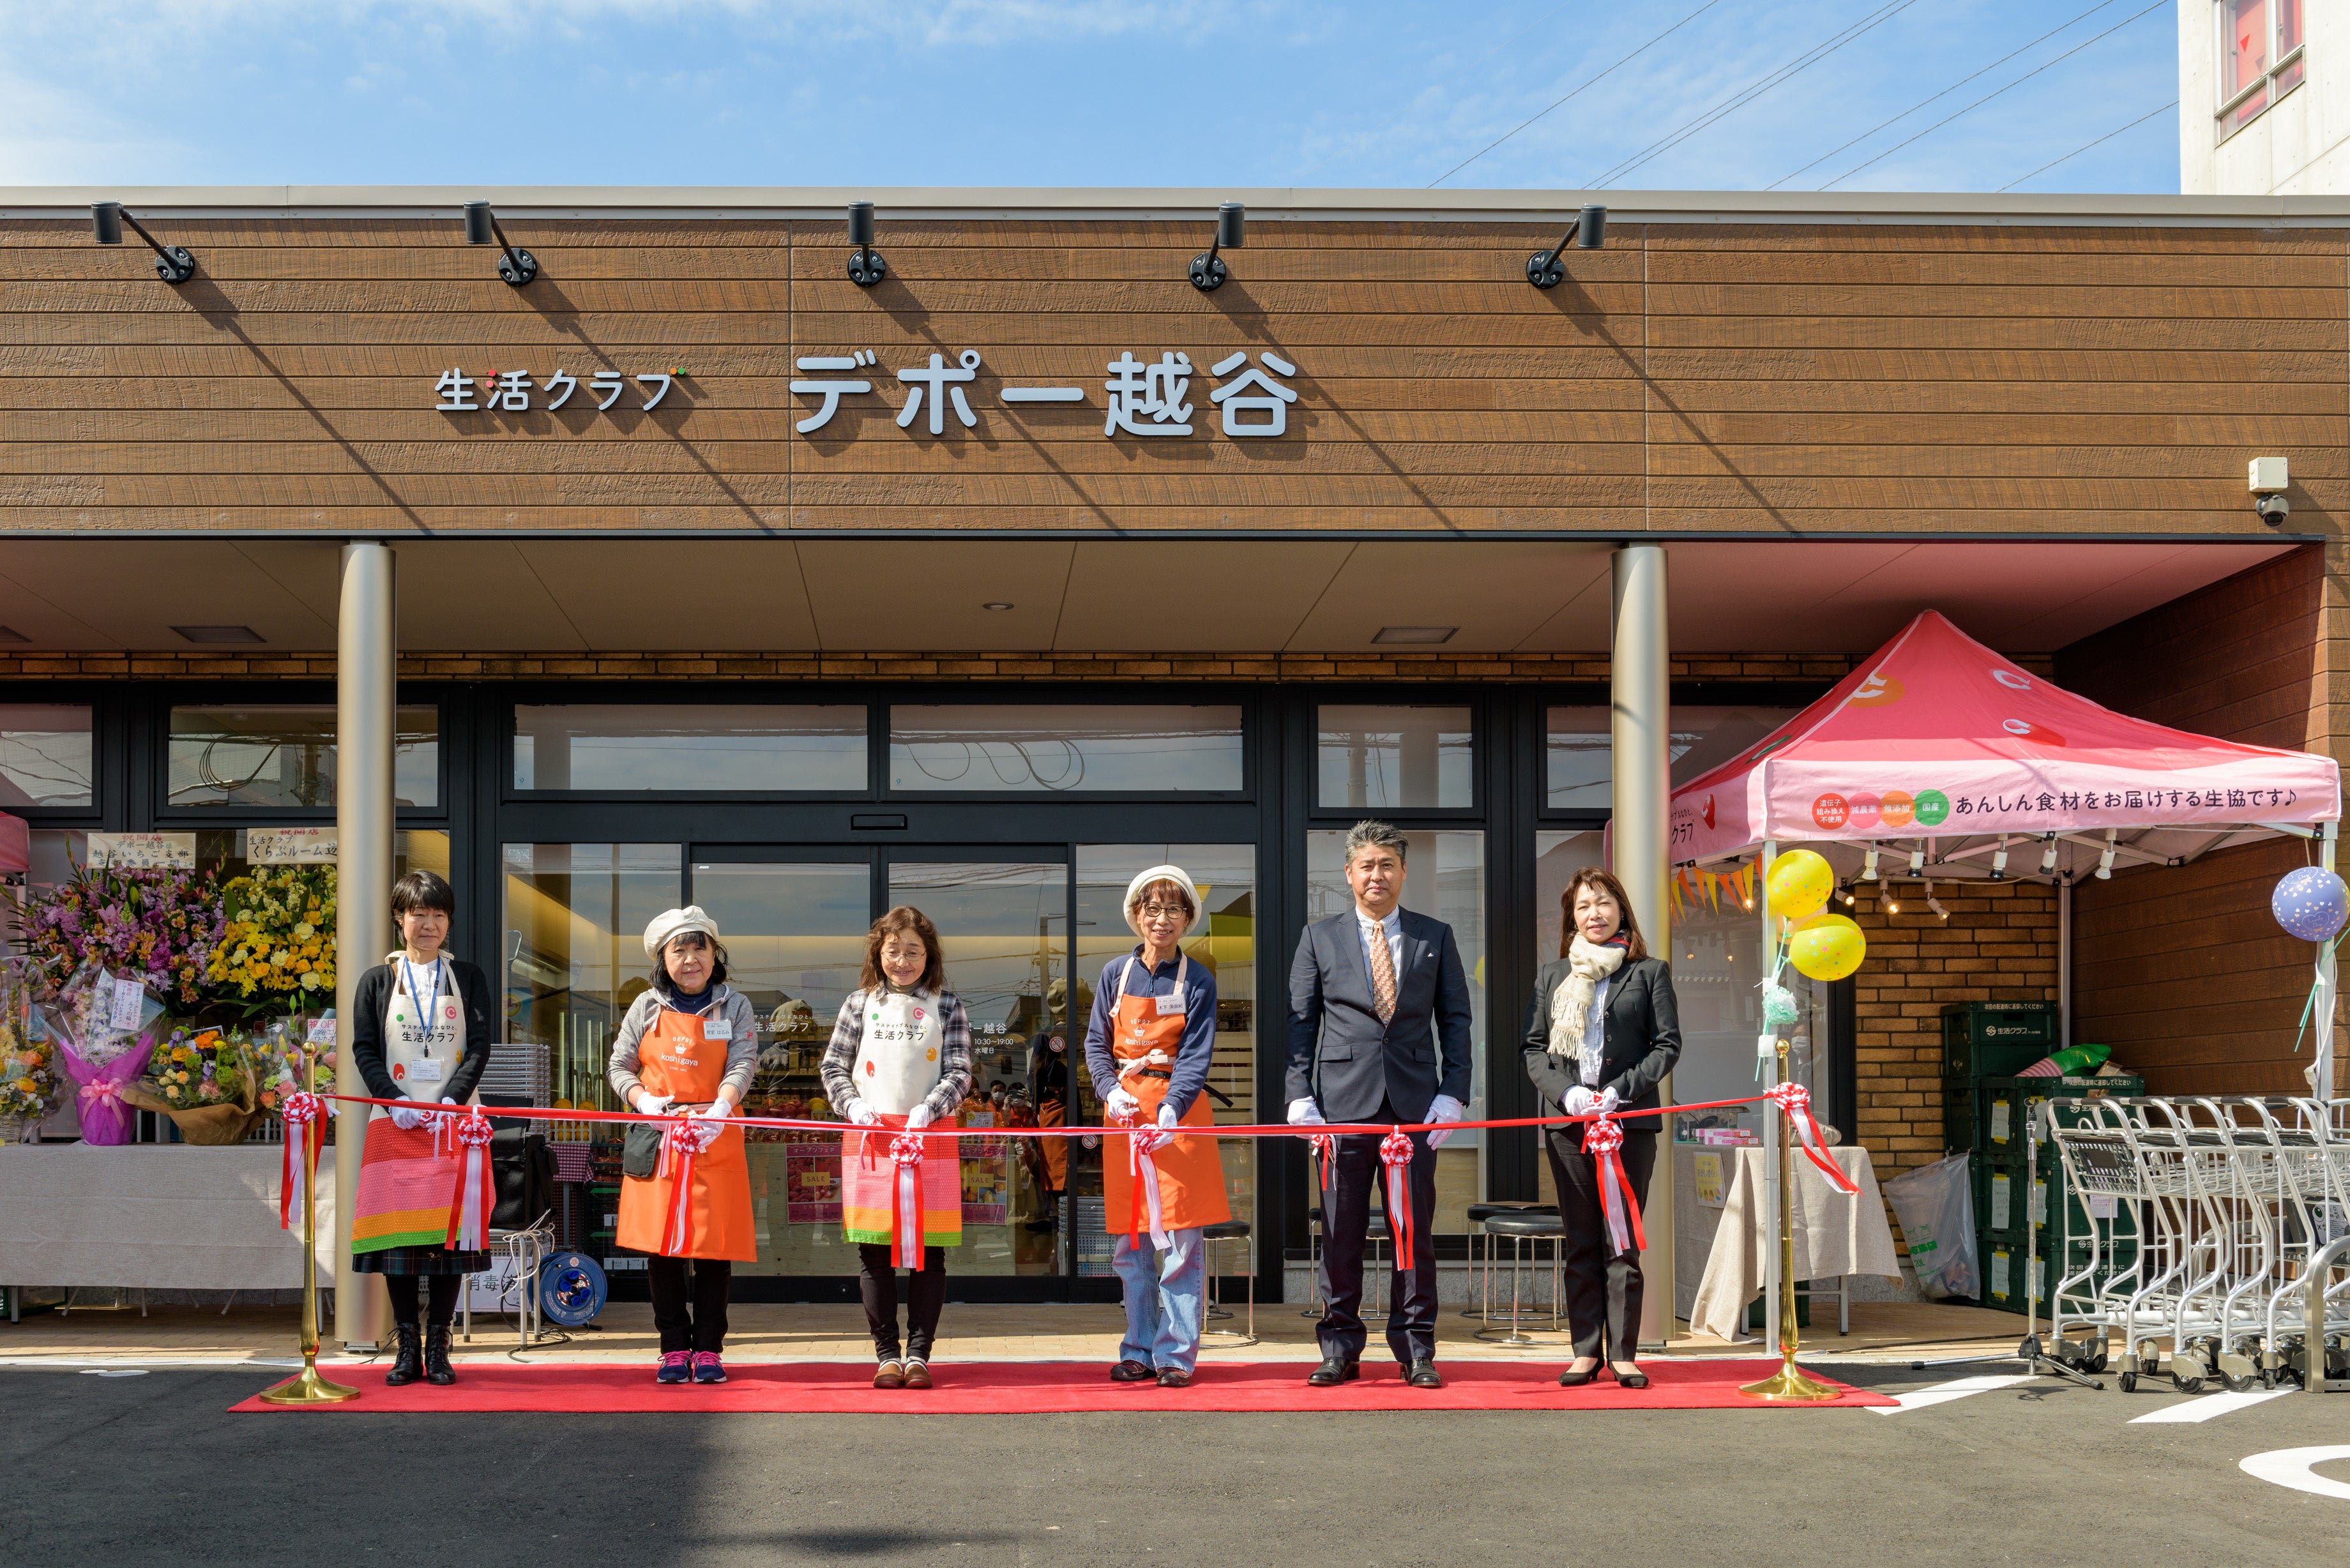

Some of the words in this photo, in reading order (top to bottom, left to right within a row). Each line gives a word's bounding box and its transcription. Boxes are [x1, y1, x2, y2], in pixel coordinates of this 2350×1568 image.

[436, 367, 686, 412] 生活クラブ
[789, 349, 1298, 437] デポー越谷
[1819, 799, 1842, 807] 遺伝子
[1922, 803, 1939, 811] 国産
[1851, 806, 1877, 814] 減農薬
[1884, 804, 1910, 813] 無添加
[249, 835, 294, 845] 生活クラブ
[755, 1021, 812, 1032] 生活クラブ
[402, 1031, 457, 1043] 生活クラブ
[874, 1029, 927, 1041] 生活クラブ
[1125, 1037, 1158, 1046] koshigaya
[661, 1053, 699, 1066] koshigaya
